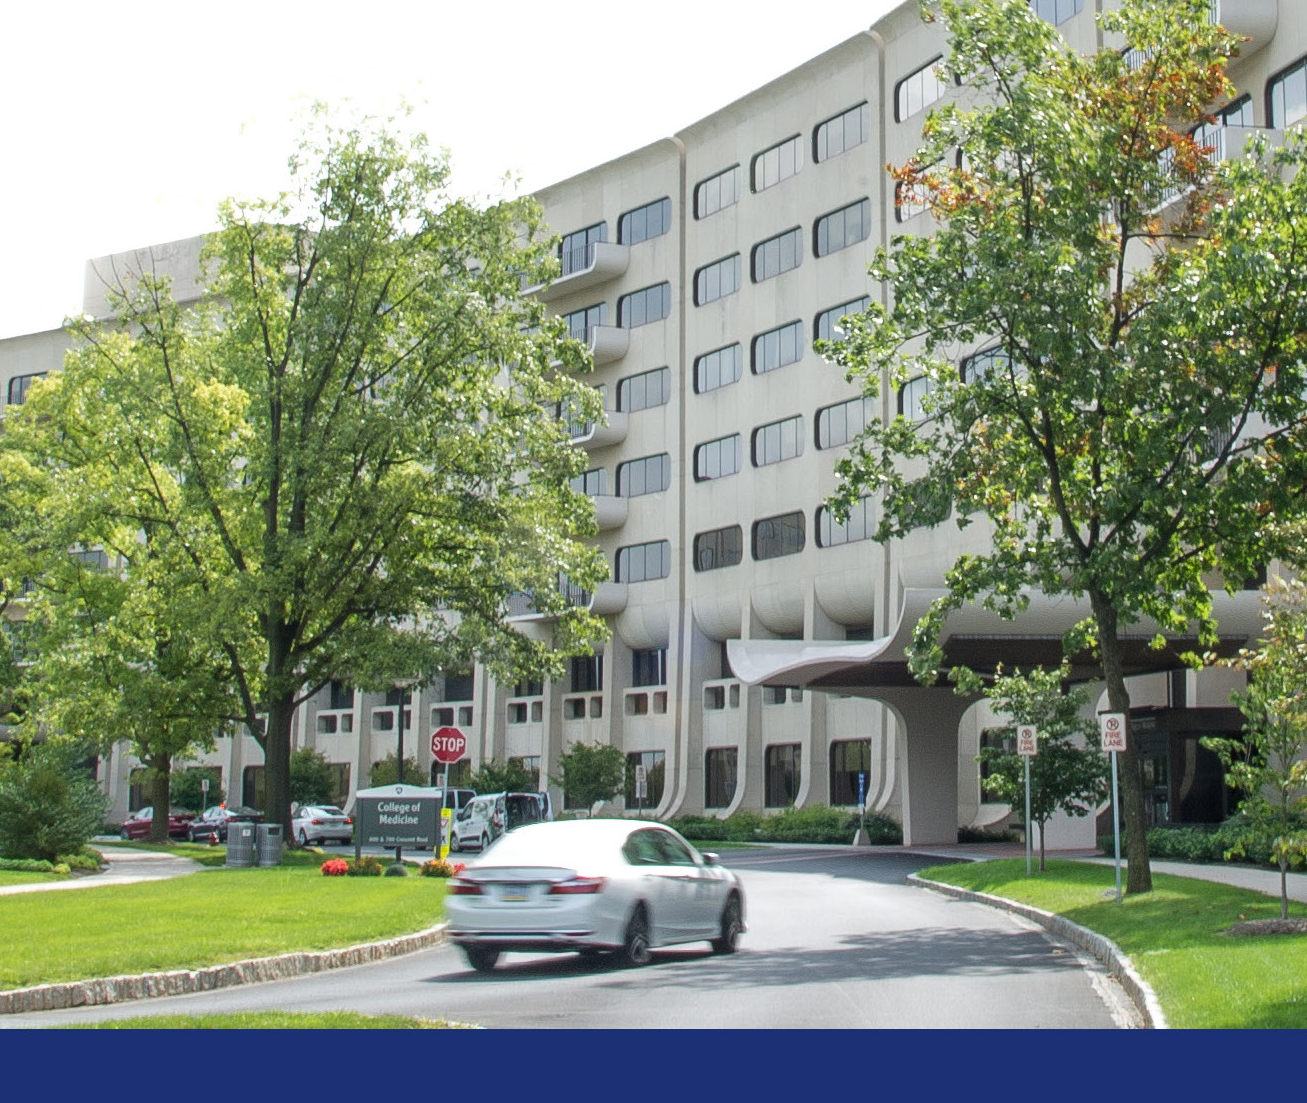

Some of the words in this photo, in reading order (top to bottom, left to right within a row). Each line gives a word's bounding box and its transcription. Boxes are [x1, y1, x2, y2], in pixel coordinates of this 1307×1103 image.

[433, 736, 464, 752] STOP
[377, 802, 410, 814] College
[411, 802, 421, 812] of
[379, 814, 419, 825] Medicine
